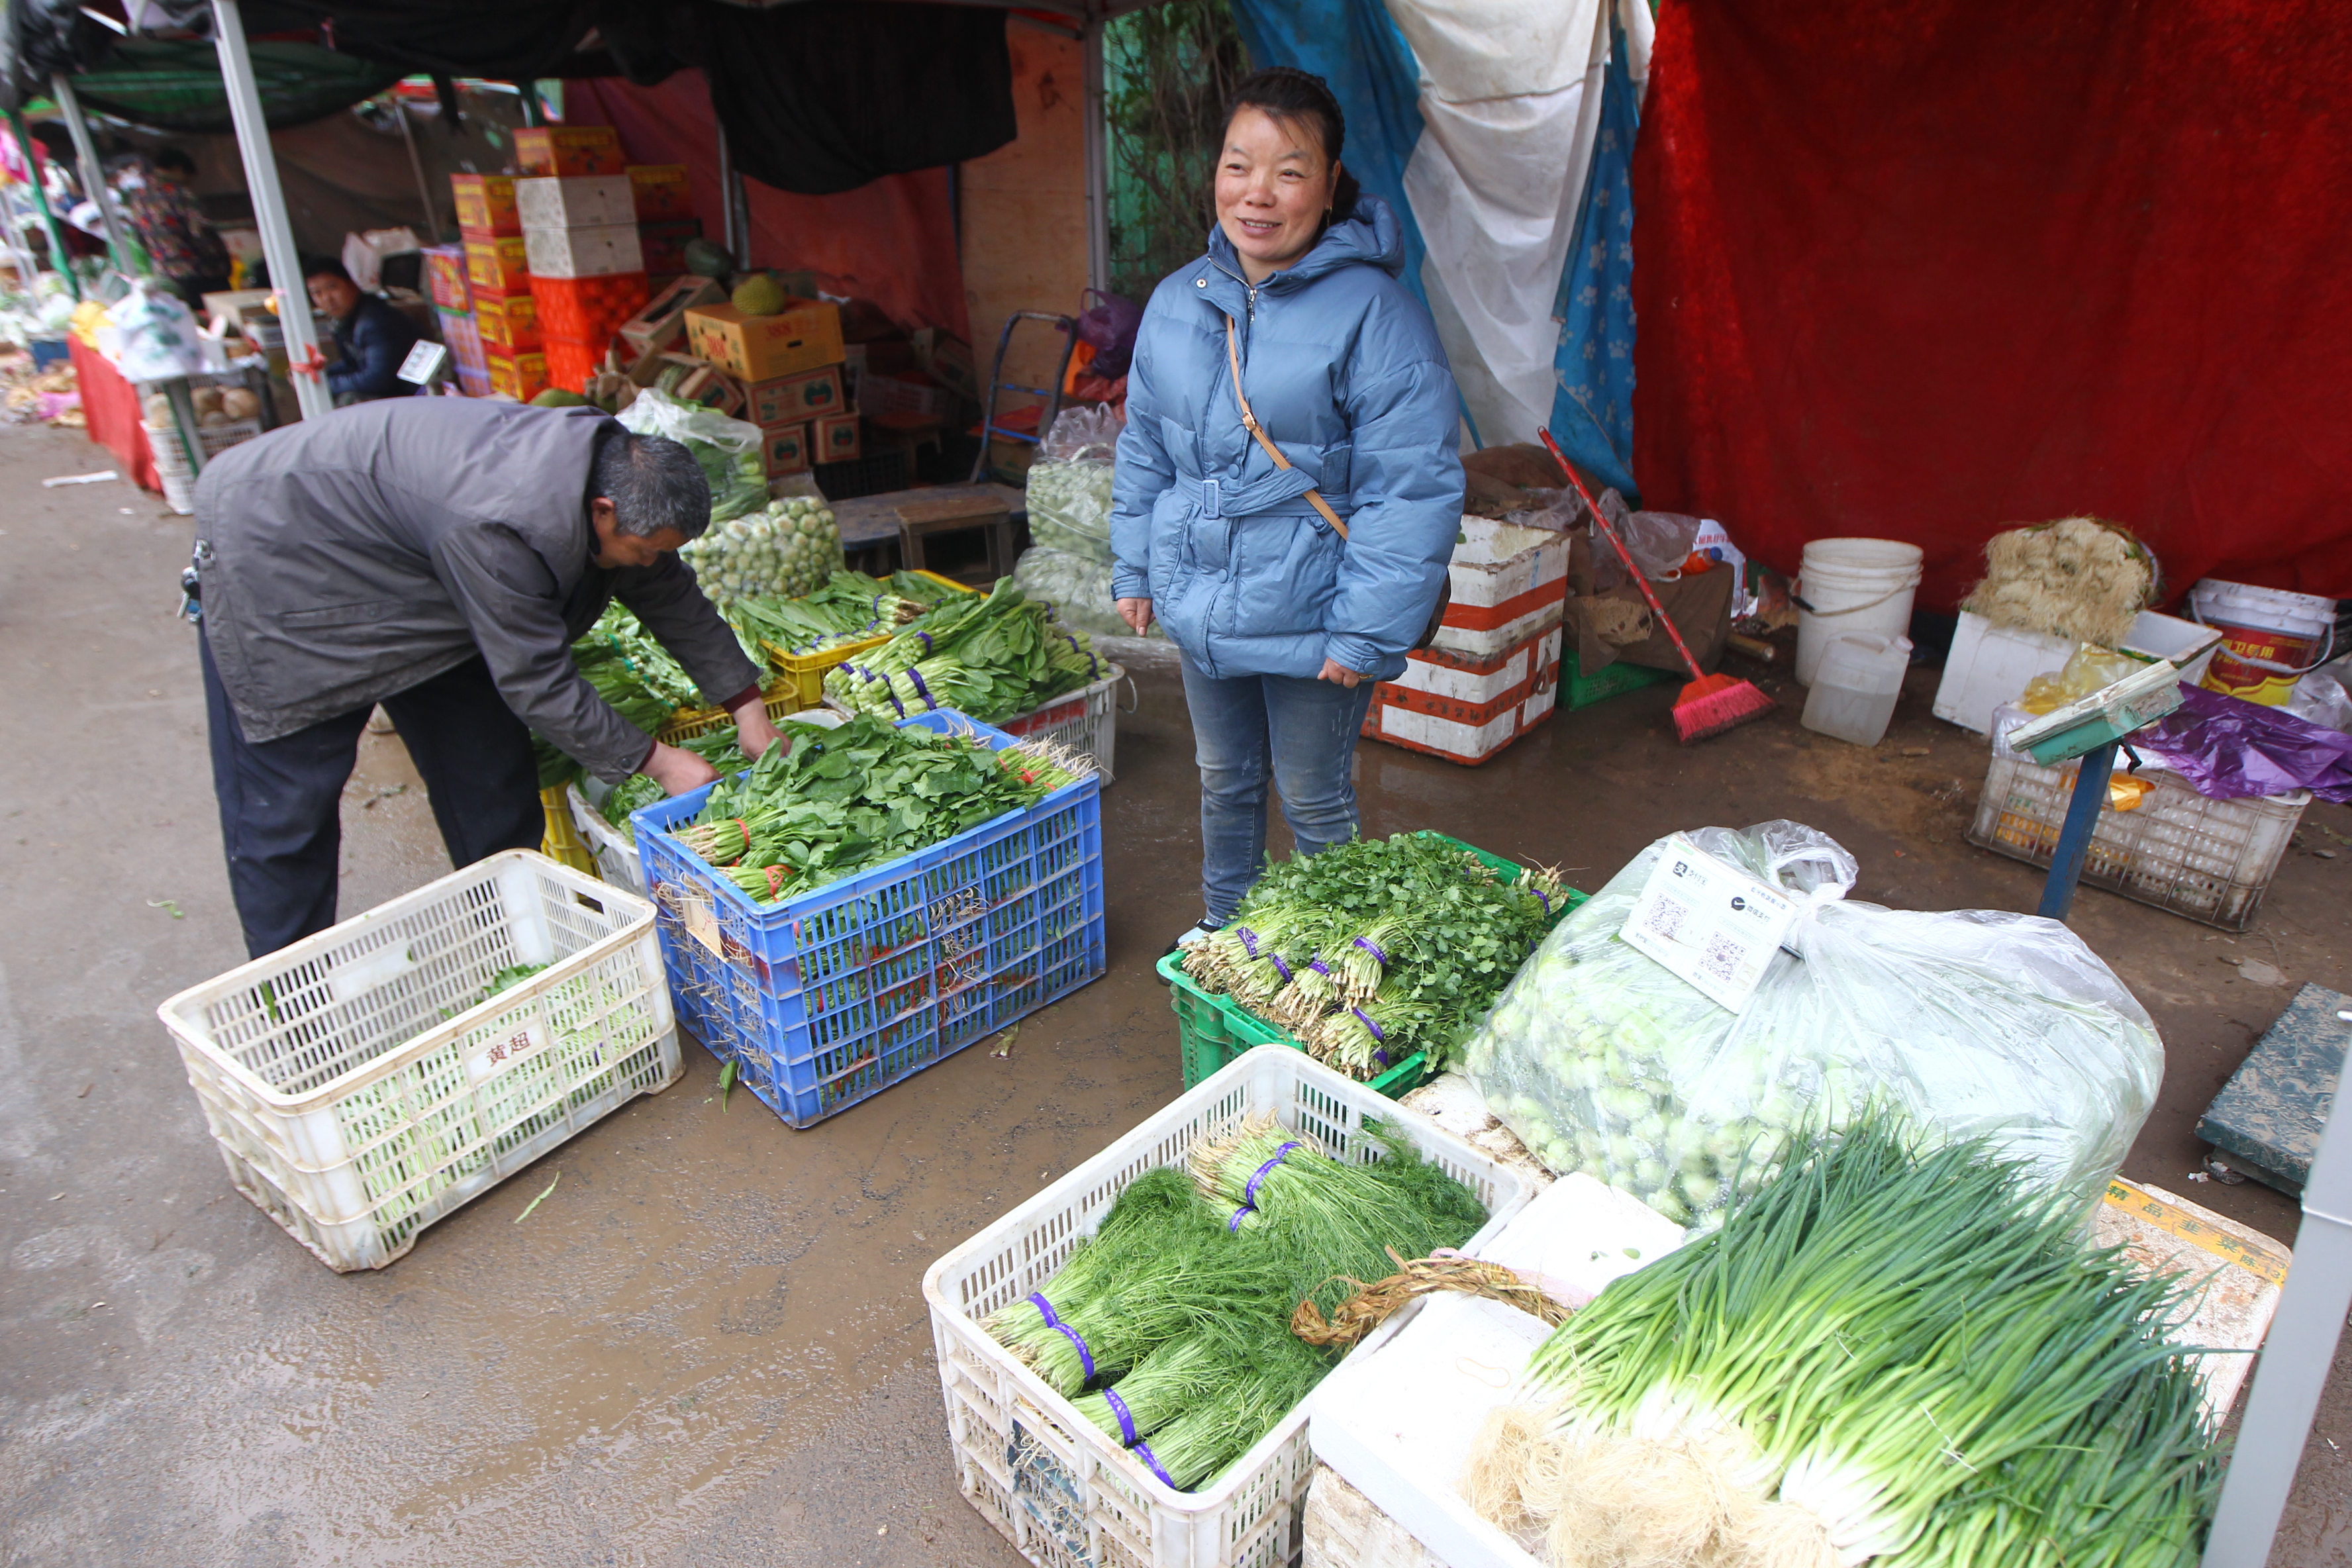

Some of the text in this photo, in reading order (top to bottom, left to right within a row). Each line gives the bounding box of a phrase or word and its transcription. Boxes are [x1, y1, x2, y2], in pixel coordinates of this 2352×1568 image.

[1685, 877, 1704, 889] ALIPAY
[1687, 869, 1708, 886] 支付宝
[1744, 912, 1767, 926] WECHAT
[1746, 905, 1771, 922] 微信支付
[486, 1031, 530, 1067] 黄超
[2107, 1184, 2241, 1253] 精品韭菜
